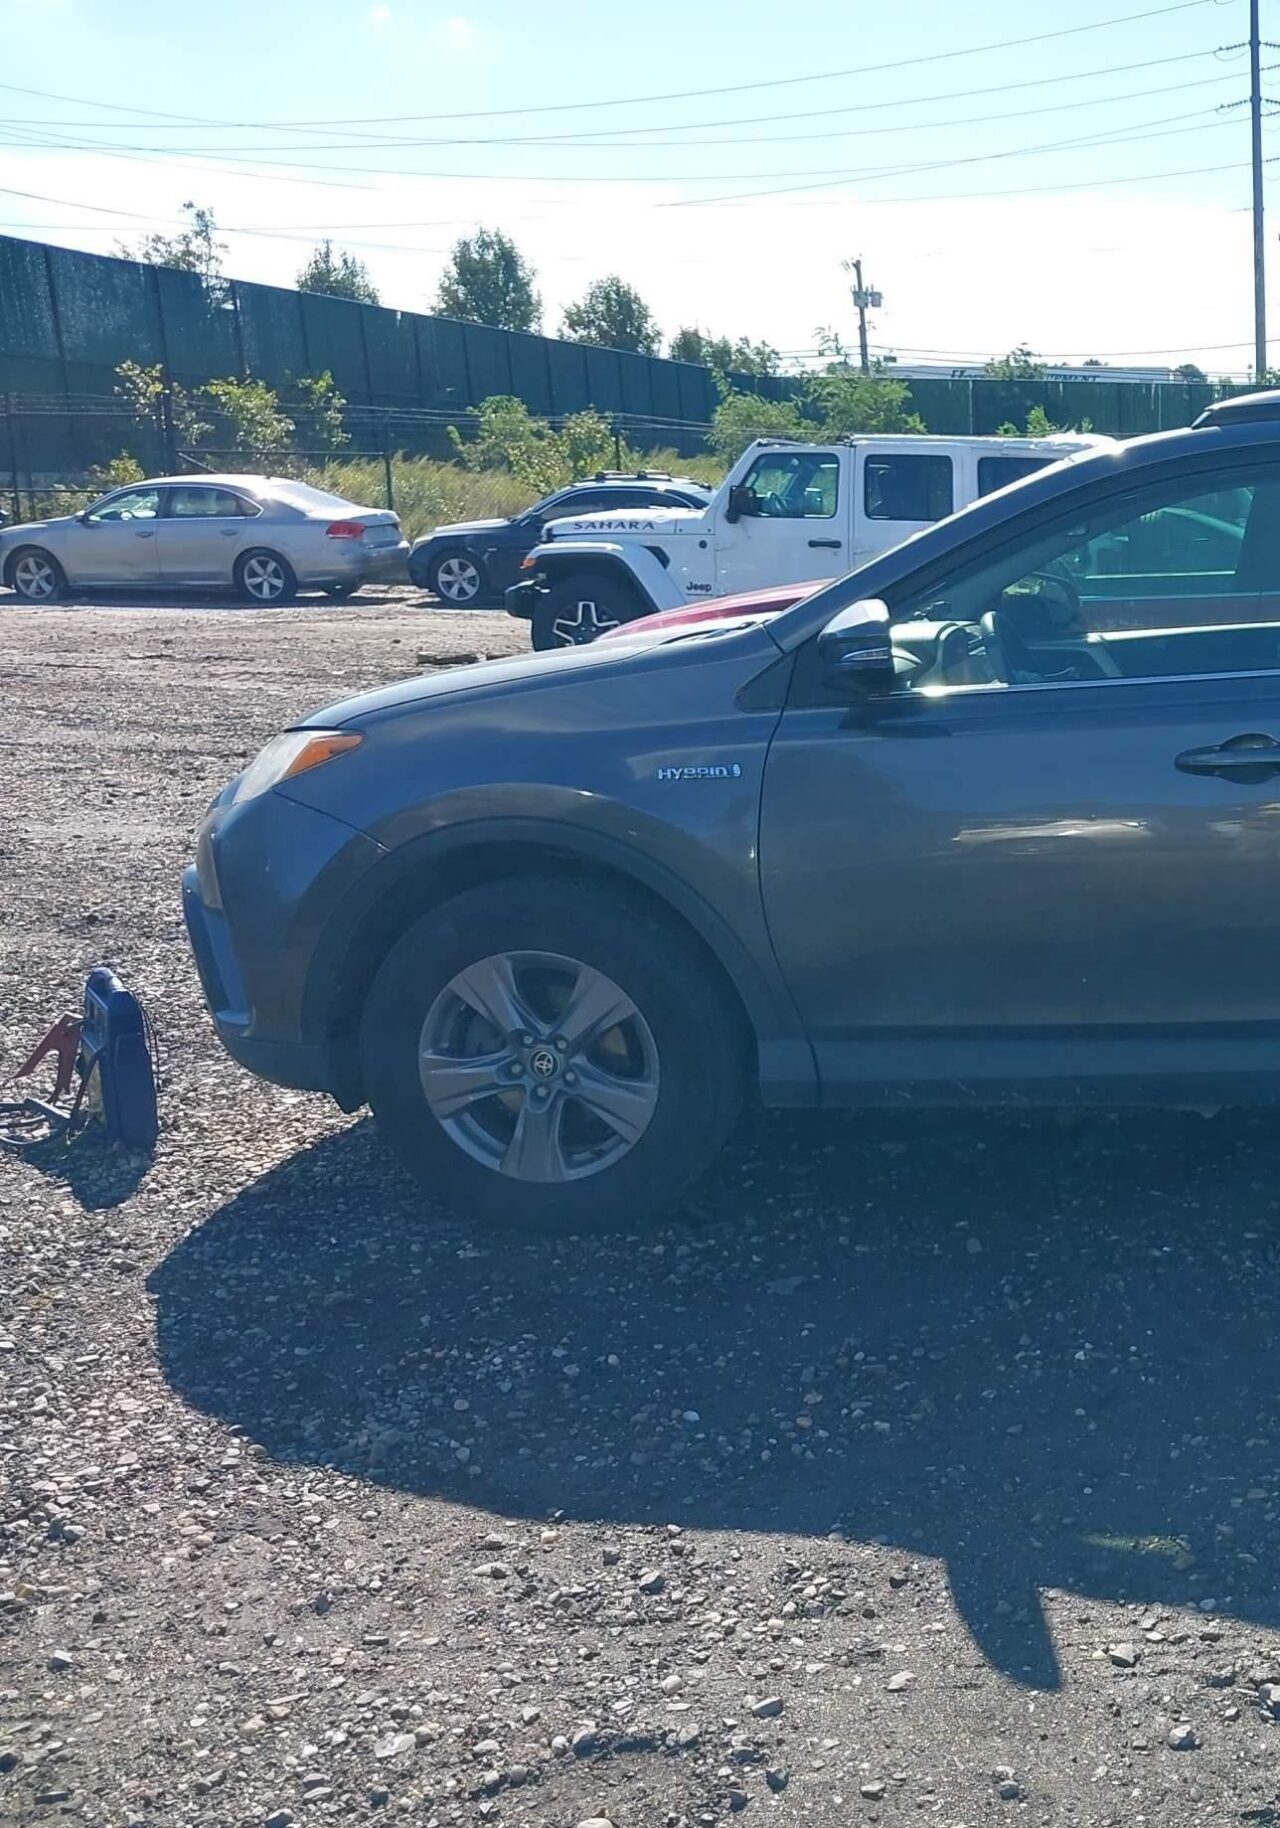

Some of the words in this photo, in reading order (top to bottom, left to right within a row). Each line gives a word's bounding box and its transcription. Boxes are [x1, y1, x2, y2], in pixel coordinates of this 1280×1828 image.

[573, 520, 655, 530] SAHARA
[686, 581, 712, 593] Jeep
[657, 766, 729, 780] HYBRID
